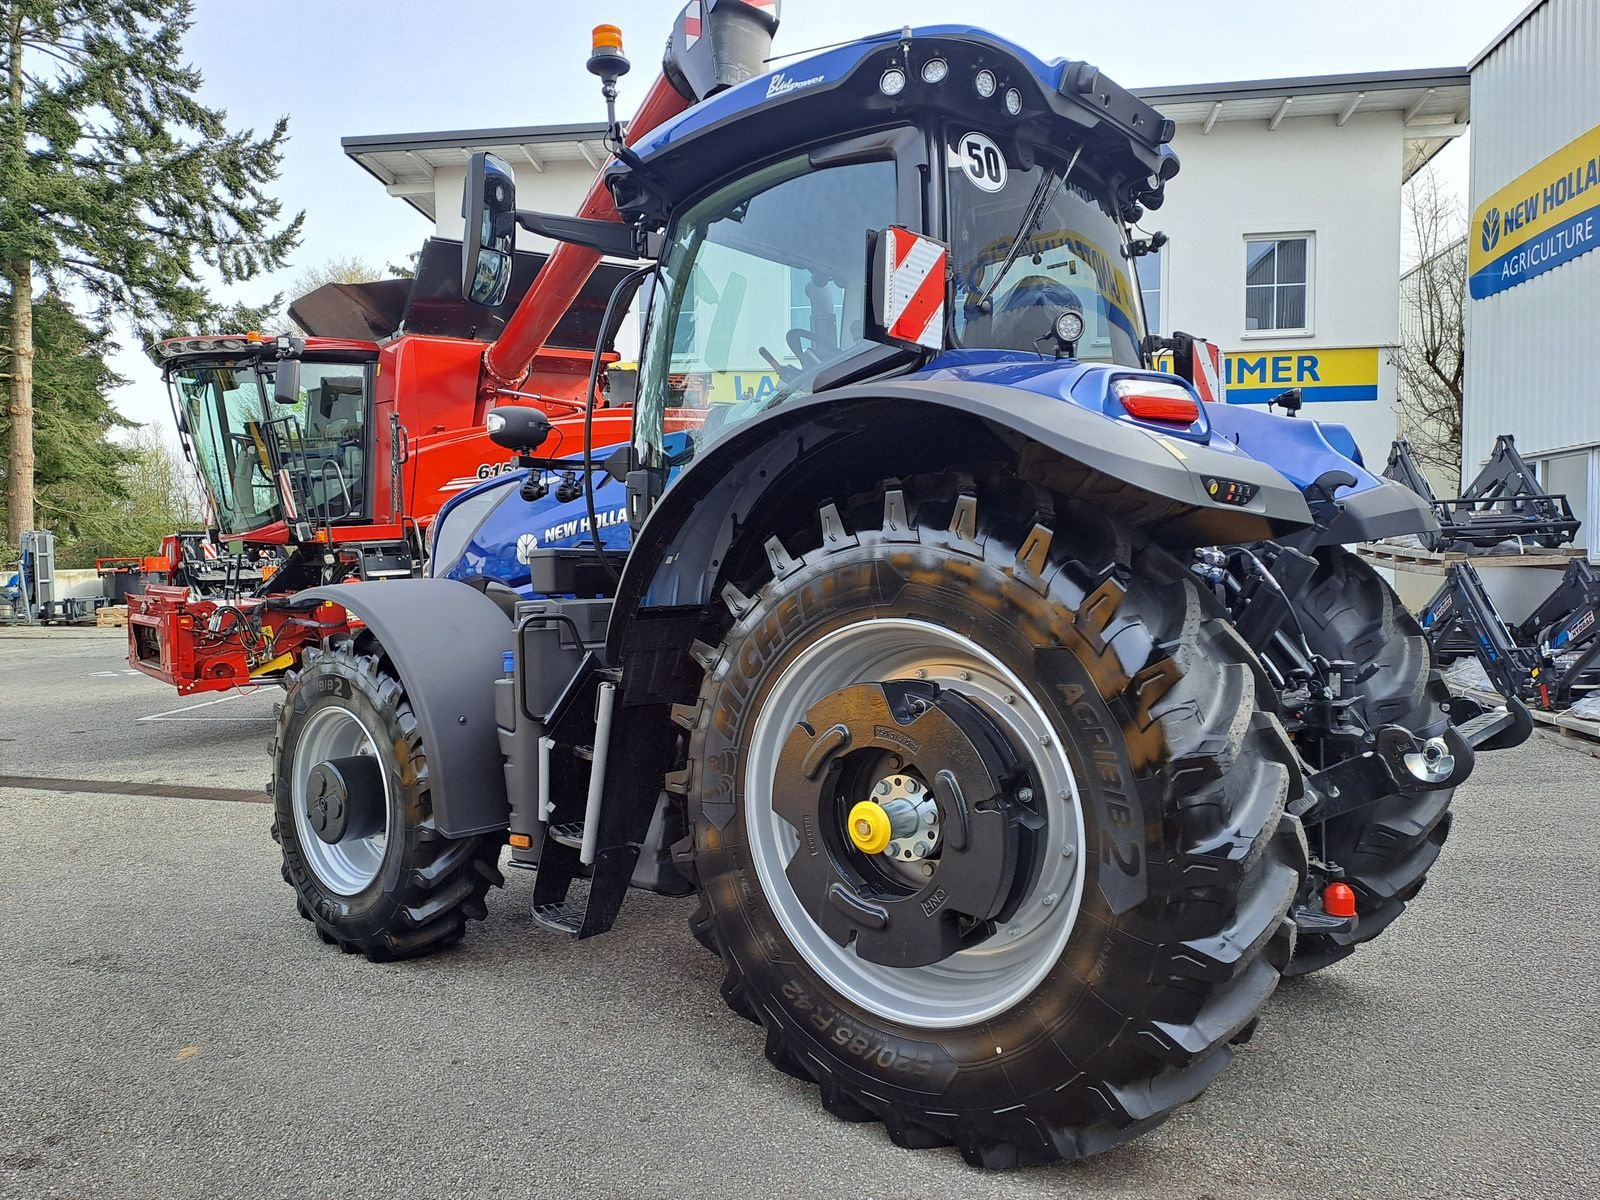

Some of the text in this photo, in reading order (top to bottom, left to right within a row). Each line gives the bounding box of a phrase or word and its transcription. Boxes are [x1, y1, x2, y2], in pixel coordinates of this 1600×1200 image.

[966, 140, 1002, 184] 50
[1503, 155, 1600, 236] NEW HOLLA
[1501, 217, 1593, 280] AGRICULTURE
[477, 462, 519, 480] 615
[544, 519, 578, 544] NEW
[712, 559, 877, 745] MICHELIN
[1056, 683, 1133, 828] AGRIBIB
[1103, 831, 1141, 877] 2
[923, 889, 946, 913] CNH
